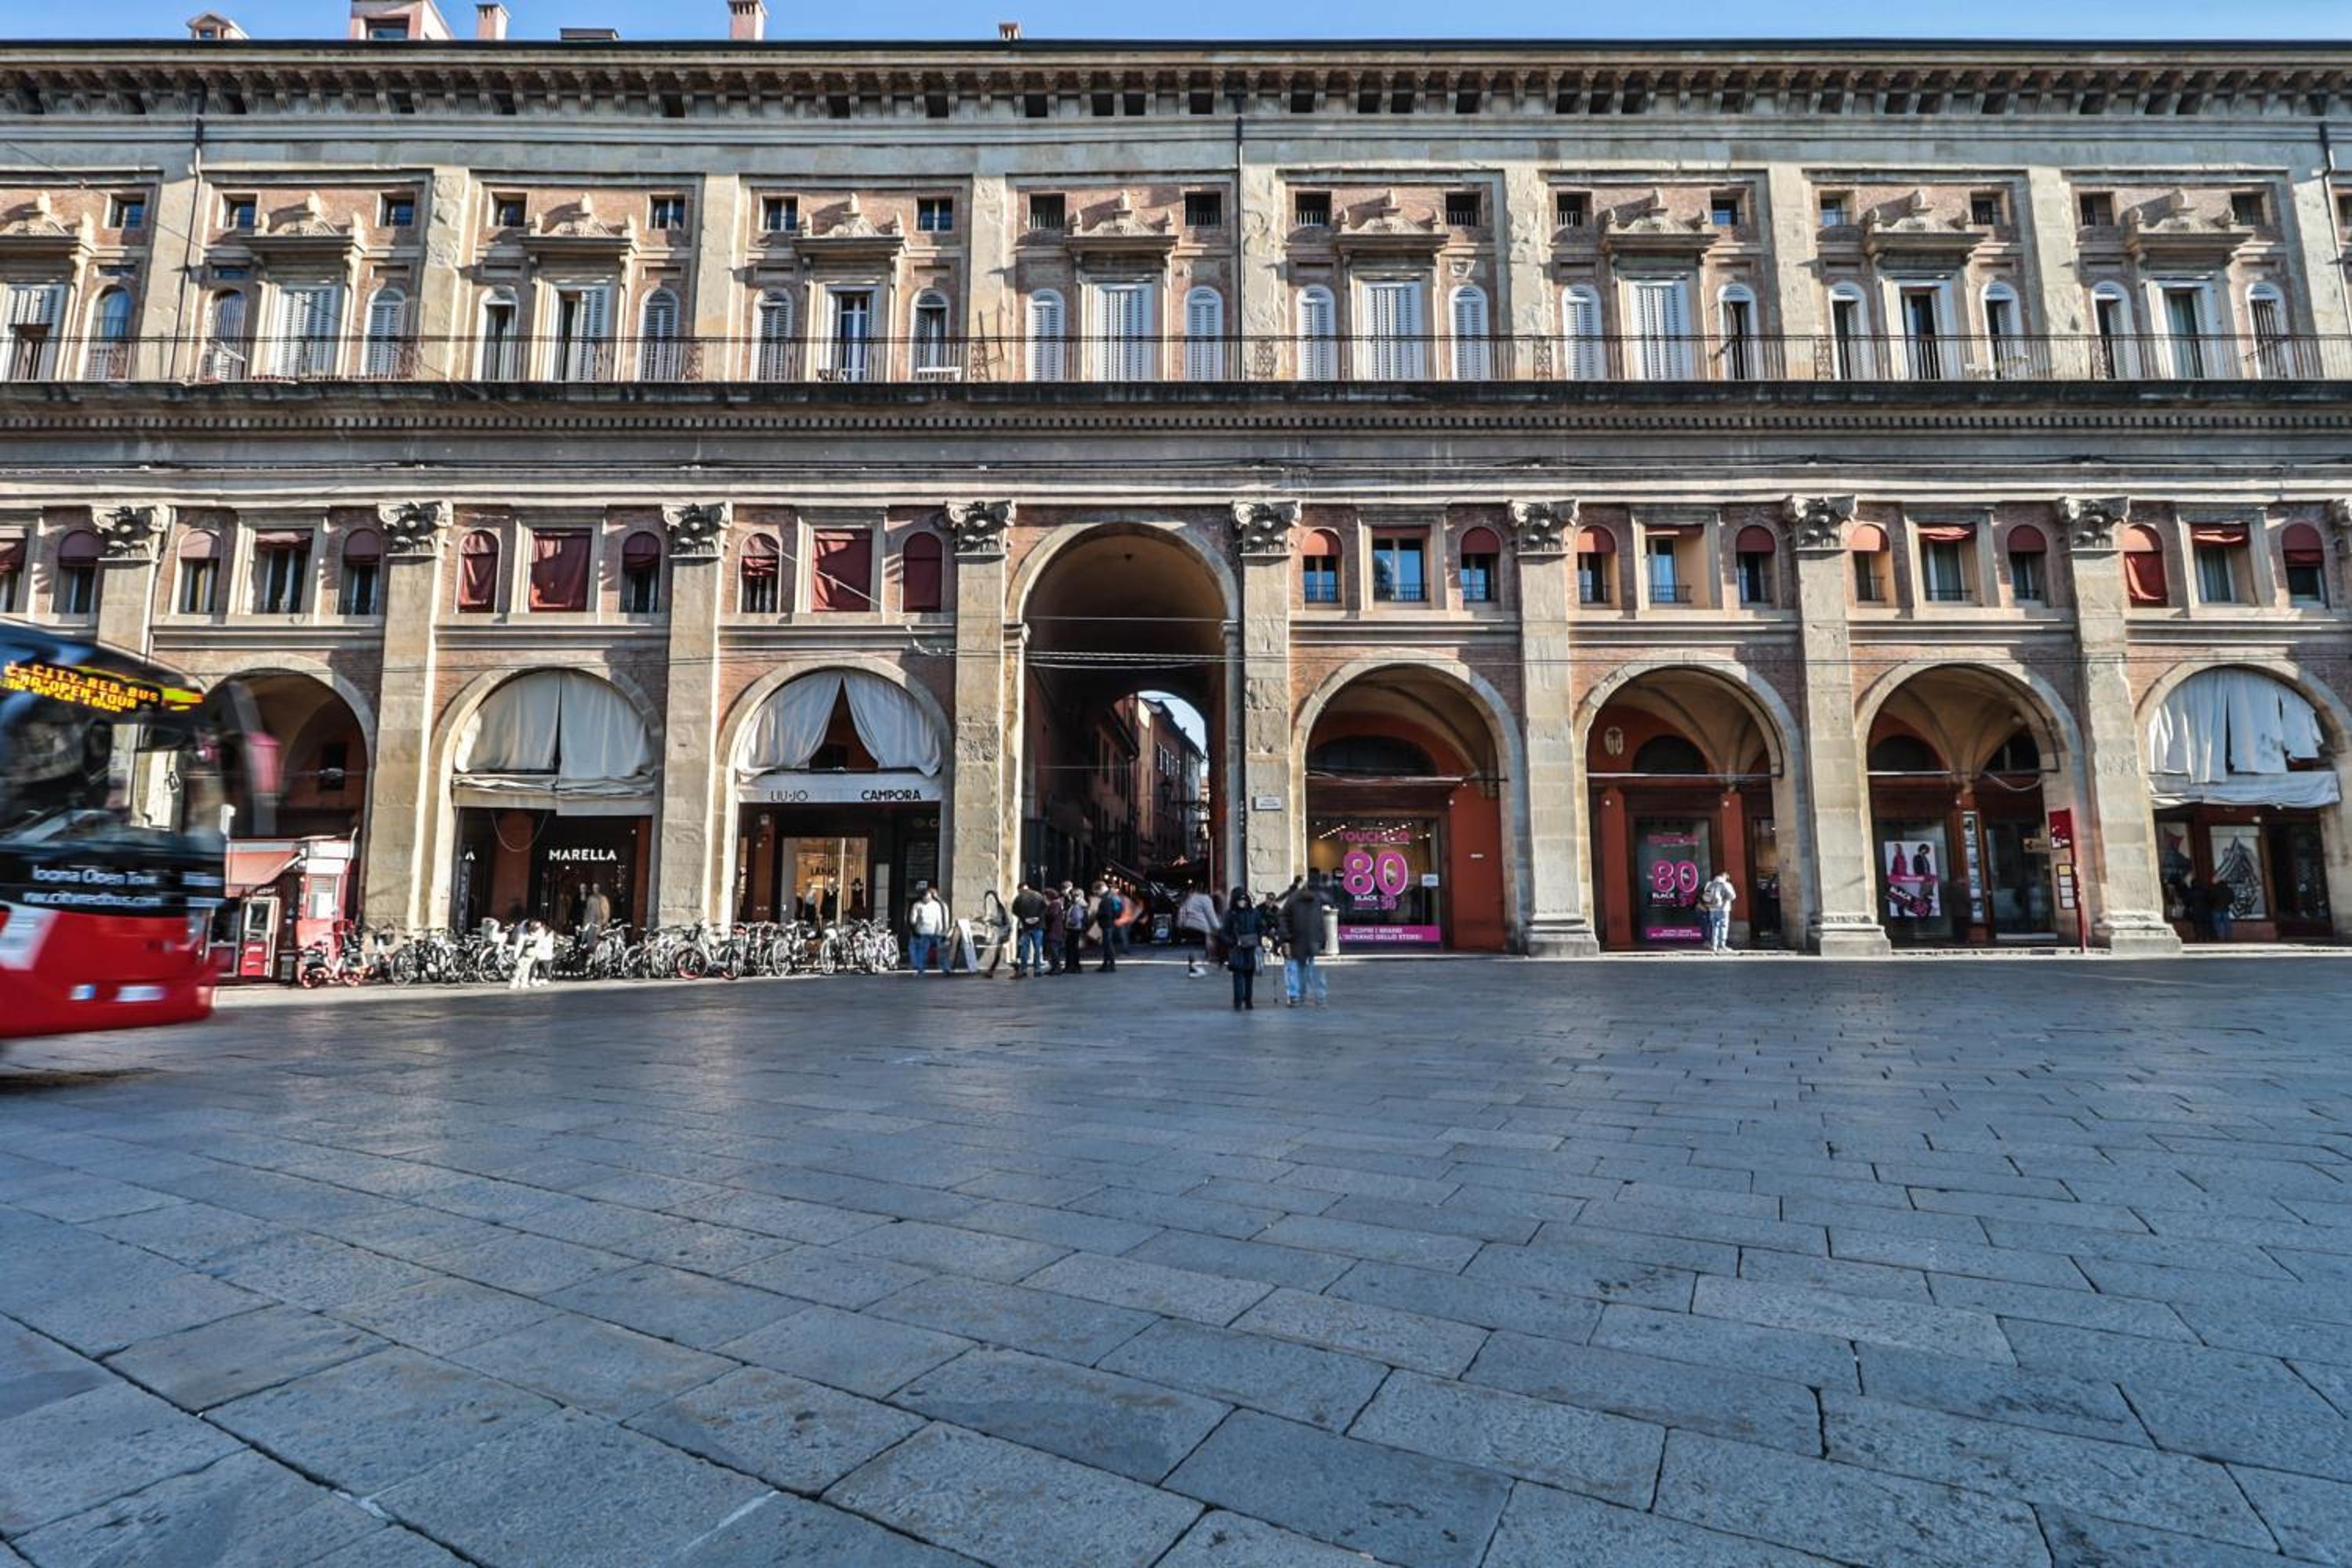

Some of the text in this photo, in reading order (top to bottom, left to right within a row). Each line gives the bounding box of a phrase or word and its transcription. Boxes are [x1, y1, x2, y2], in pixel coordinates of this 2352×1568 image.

[88, 677, 121, 693] RED
[129, 687, 158, 702] BUS
[99, 691, 136, 709] TOUR
[861, 789, 921, 800] CAMPORA
[549, 849, 617, 860] MARELLA
